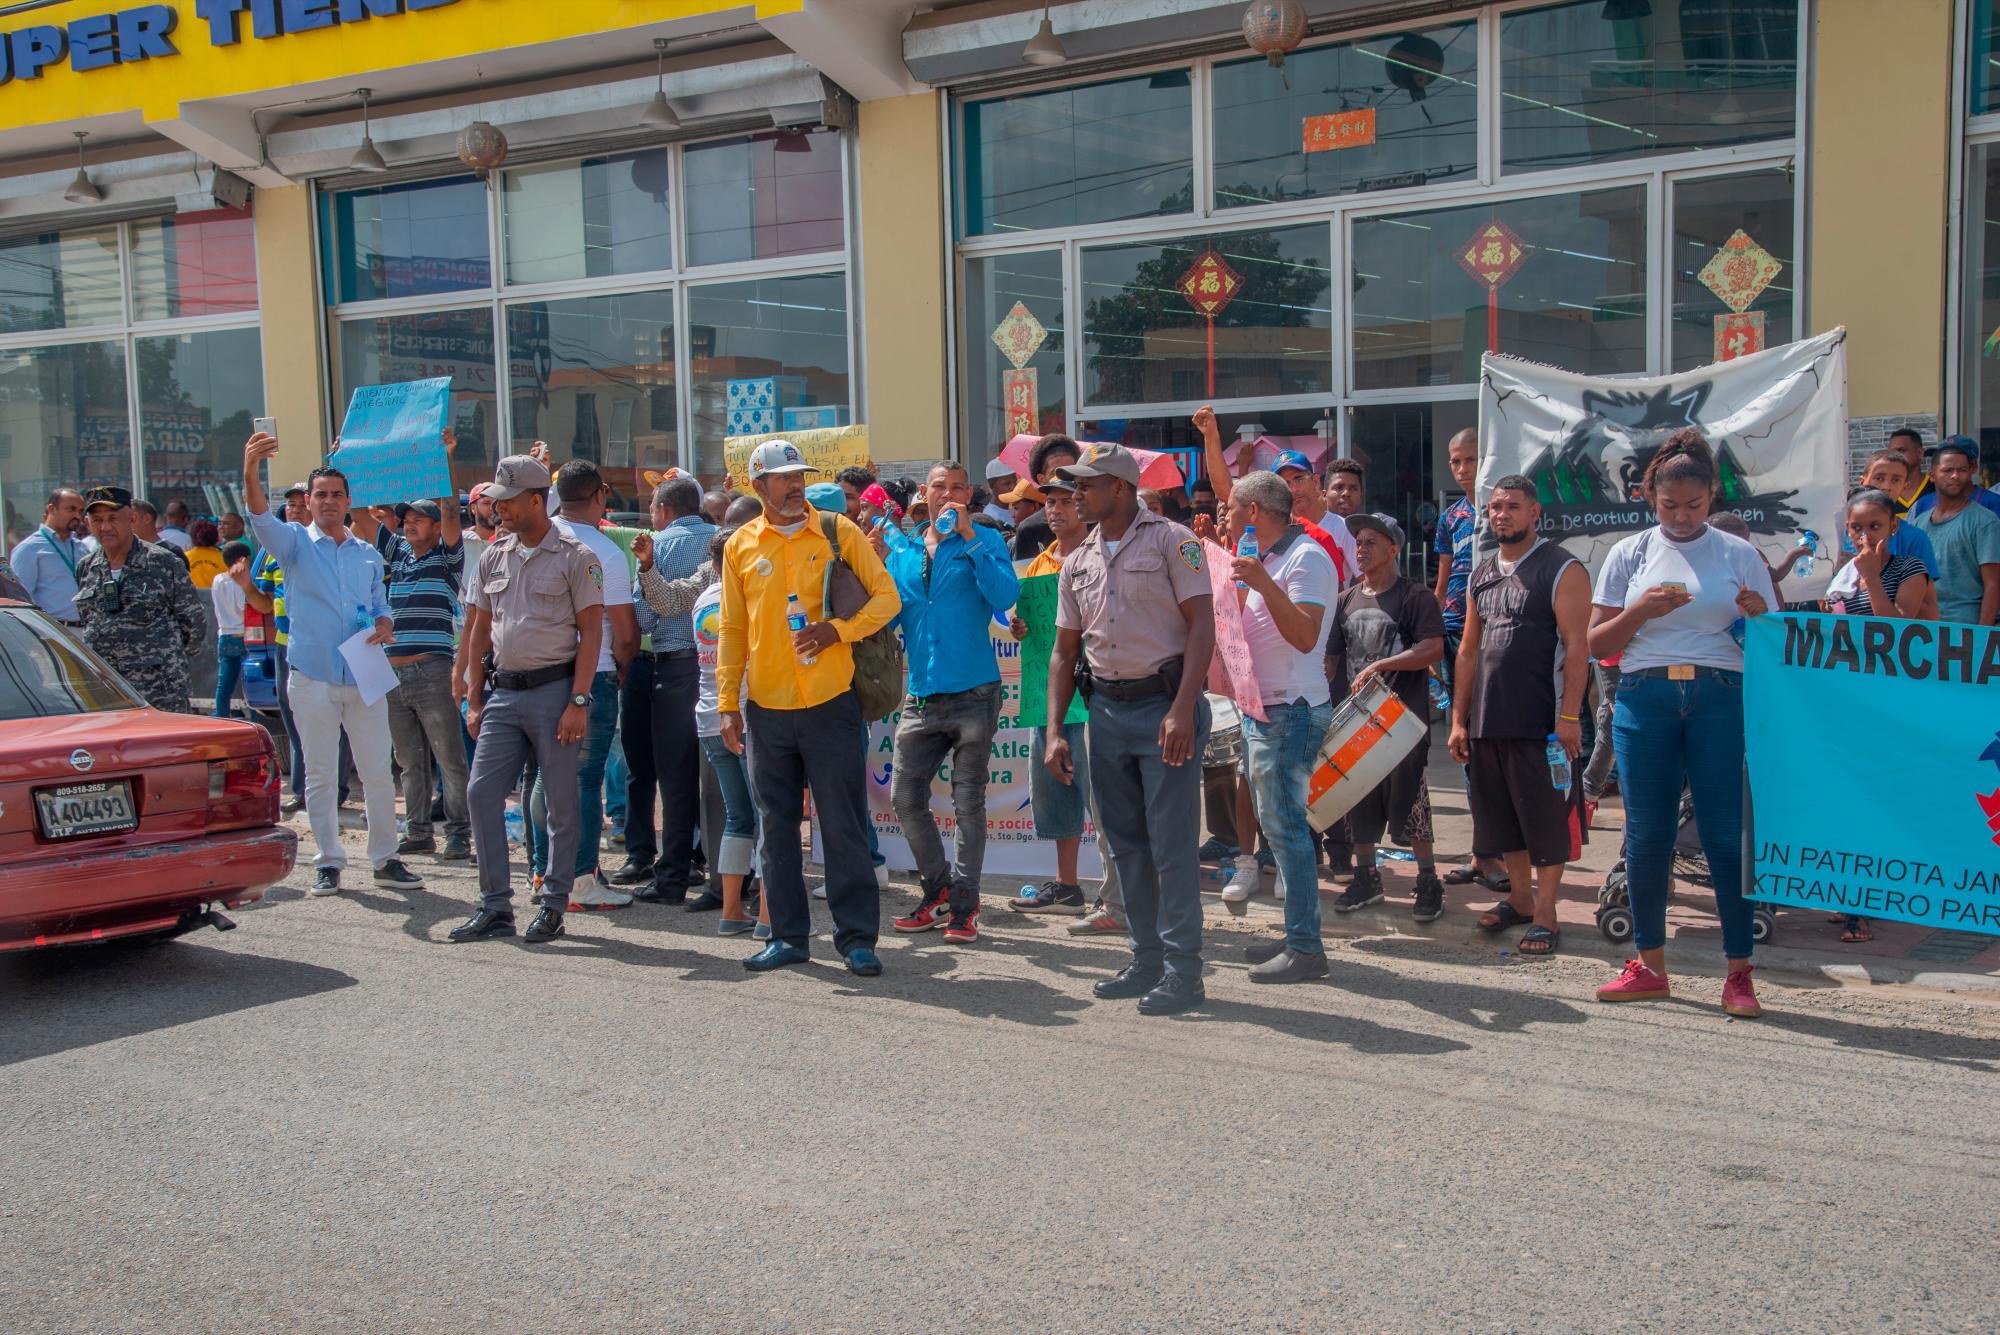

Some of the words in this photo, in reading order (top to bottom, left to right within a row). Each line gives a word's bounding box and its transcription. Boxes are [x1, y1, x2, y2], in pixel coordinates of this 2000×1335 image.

[1199, 271, 1221, 294] 福
[1784, 617, 2000, 685] MARCHA
[56, 783, 106, 796] 809-518-2652
[998, 820, 1034, 830] socie
[1799, 847, 1945, 888] PATRIOTA
